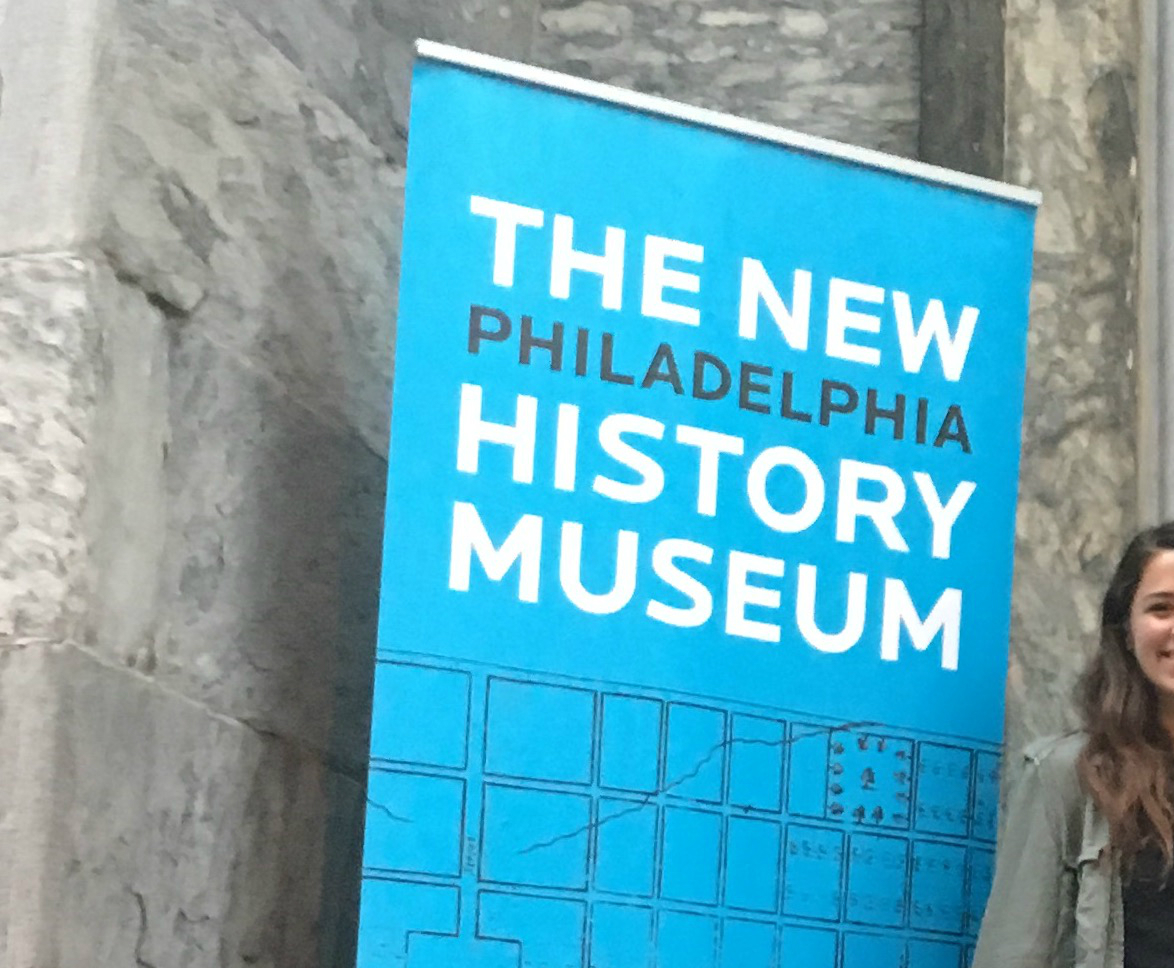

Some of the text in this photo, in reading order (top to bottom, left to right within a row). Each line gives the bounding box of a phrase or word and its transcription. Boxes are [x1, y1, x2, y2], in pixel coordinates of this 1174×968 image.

[469, 194, 980, 382] THE NEW
[467, 304, 973, 455] PHILADELPHIA
[456, 383, 977, 560] HISTORY
[448, 500, 963, 671] MUSEUM
